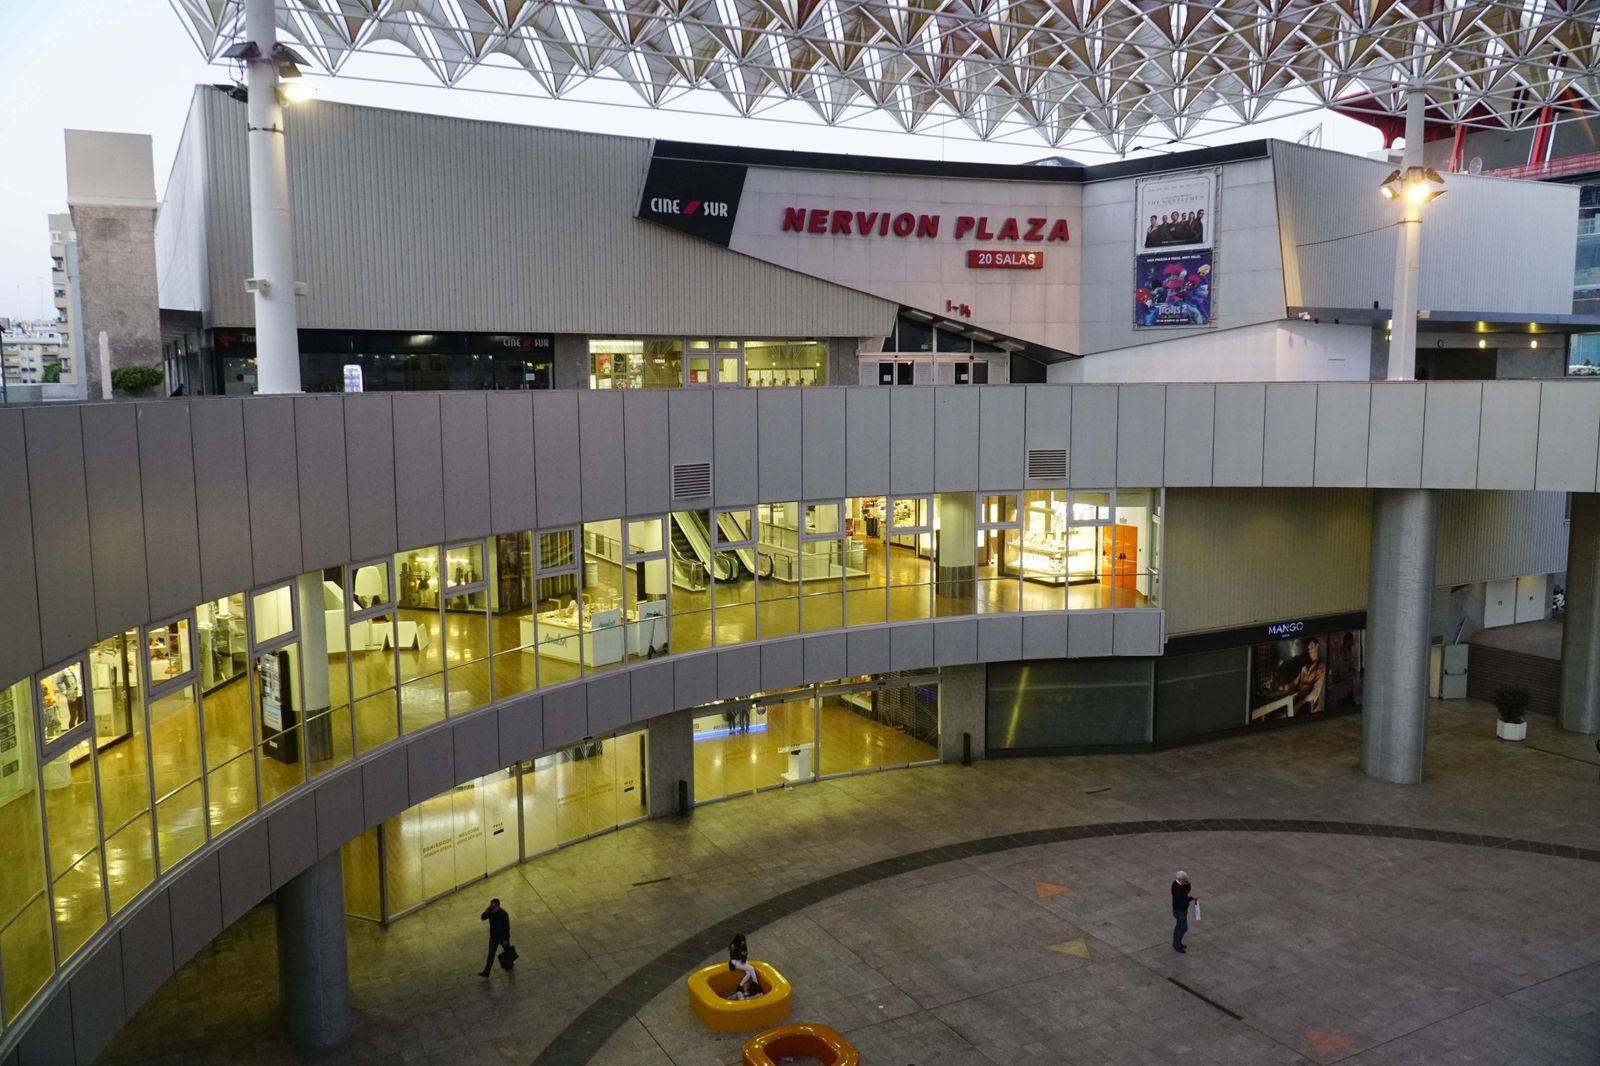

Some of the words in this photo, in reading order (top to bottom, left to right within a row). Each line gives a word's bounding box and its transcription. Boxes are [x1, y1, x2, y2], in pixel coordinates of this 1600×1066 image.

[651, 197, 681, 214] CINE
[703, 201, 728, 217] SUR
[782, 207, 940, 239] NERVION
[954, 215, 1070, 241] PLAZA
[978, 253, 992, 265] 20
[995, 253, 1036, 266] SALAS
[503, 338, 521, 347] CINE
[534, 338, 550, 348] SUR
[1268, 621, 1304, 635] MANGO
